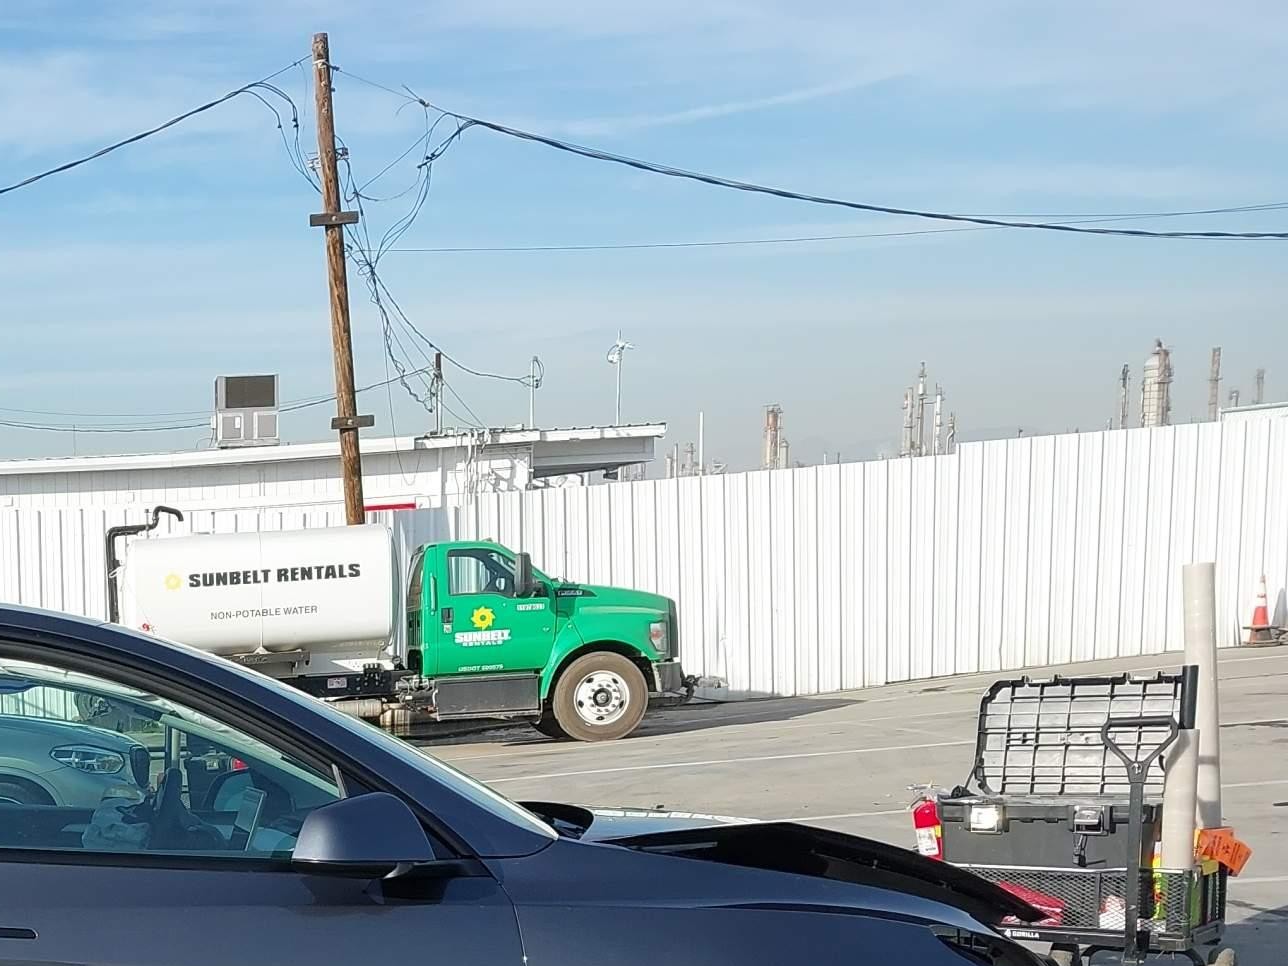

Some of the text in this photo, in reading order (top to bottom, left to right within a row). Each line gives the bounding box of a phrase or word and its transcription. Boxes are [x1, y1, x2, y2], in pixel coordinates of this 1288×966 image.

[188, 563, 361, 588] SUNBELT RENTALS
[210, 605, 318, 620] NON-POTABLE WATER
[454, 629, 511, 644] SUNBELT
[1012, 930, 1040, 939] GORILLA
